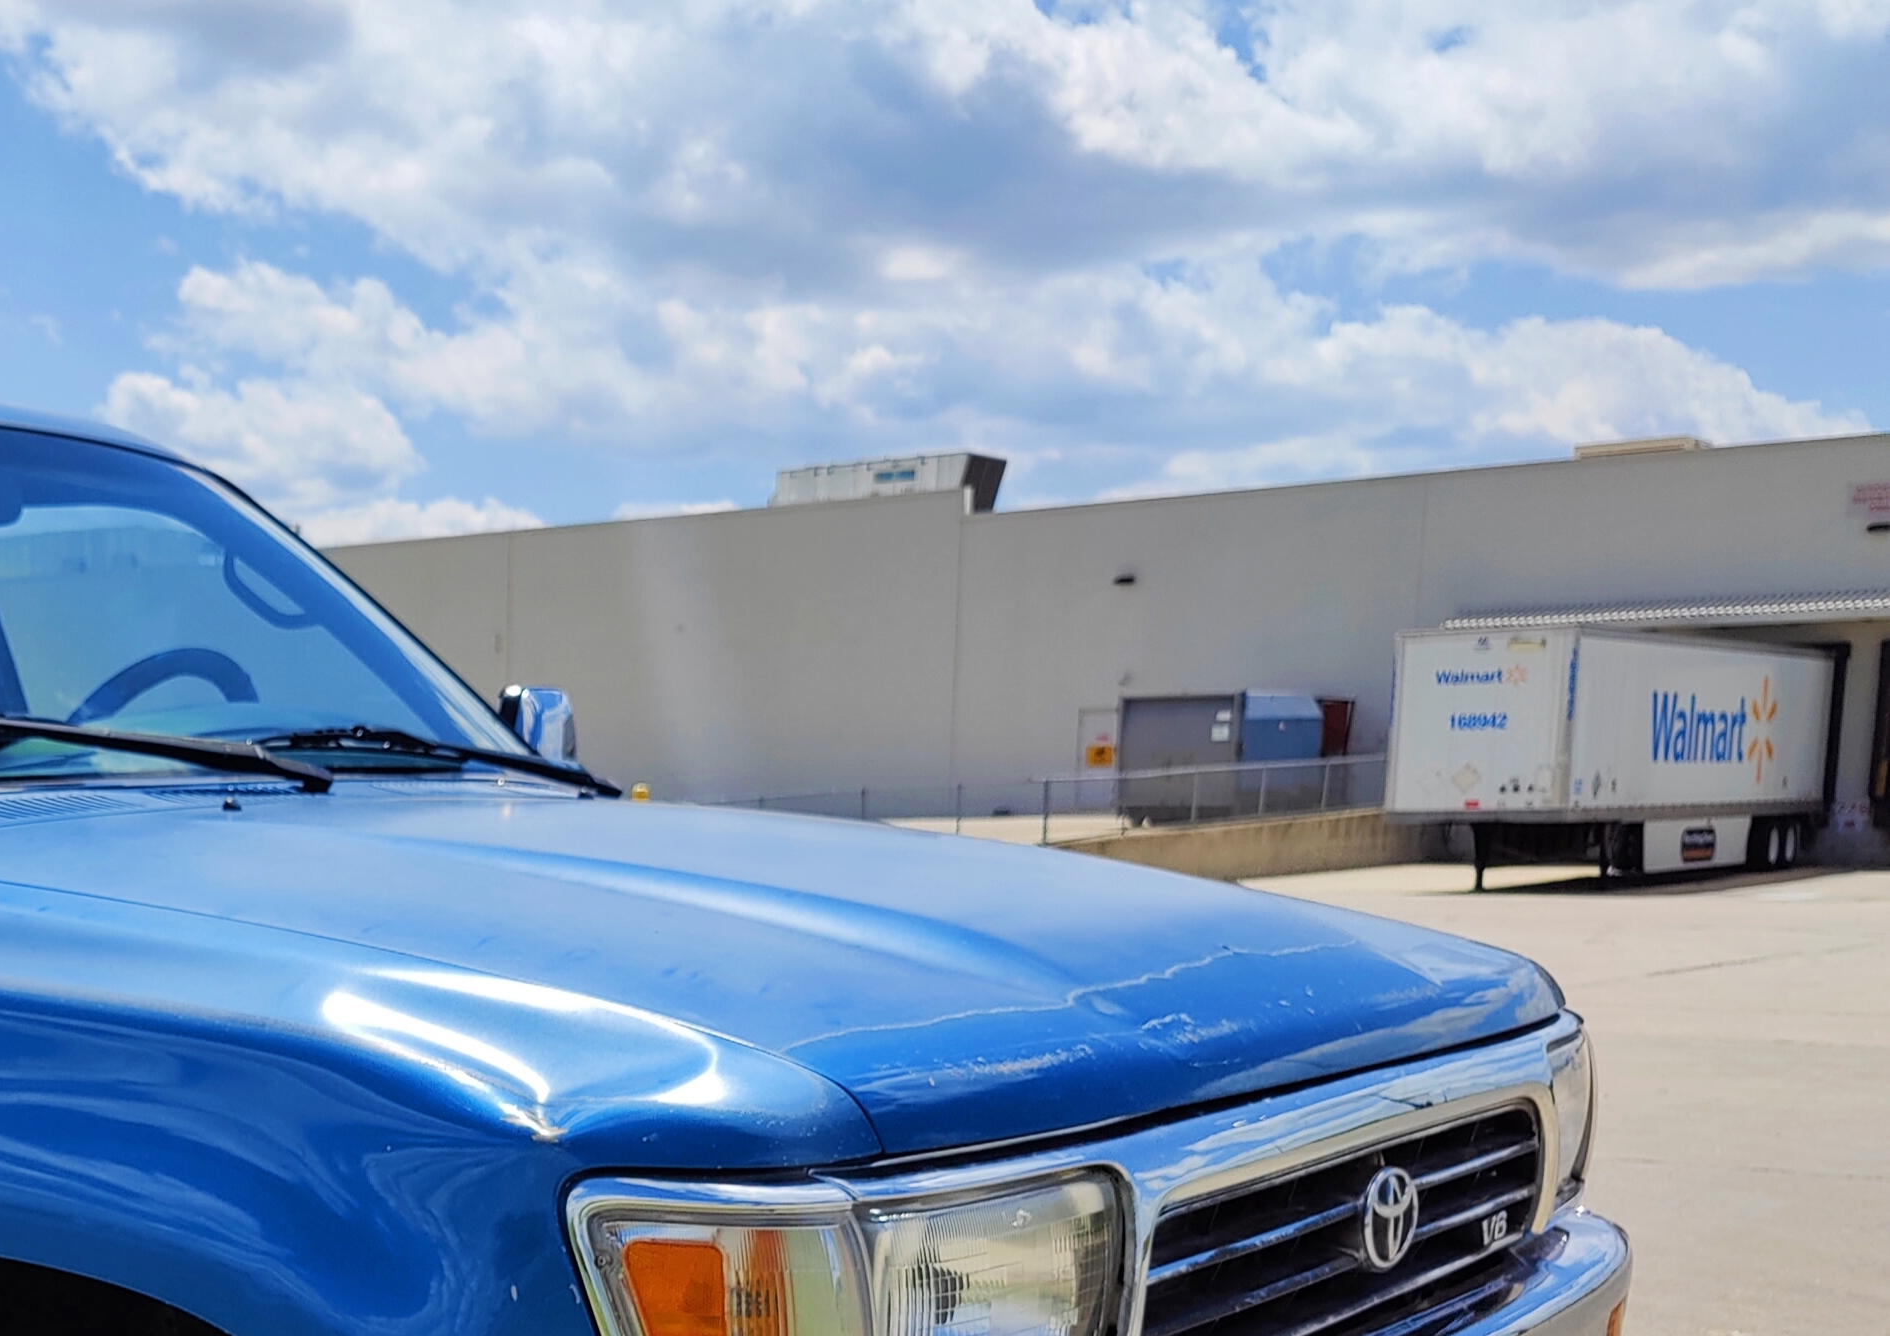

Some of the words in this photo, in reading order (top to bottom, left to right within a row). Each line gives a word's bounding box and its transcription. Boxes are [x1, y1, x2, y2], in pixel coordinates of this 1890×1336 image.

[1436, 667, 1503, 685] Walmart
[1652, 689, 1747, 764] Walmart
[1482, 1210, 1507, 1246] V6
